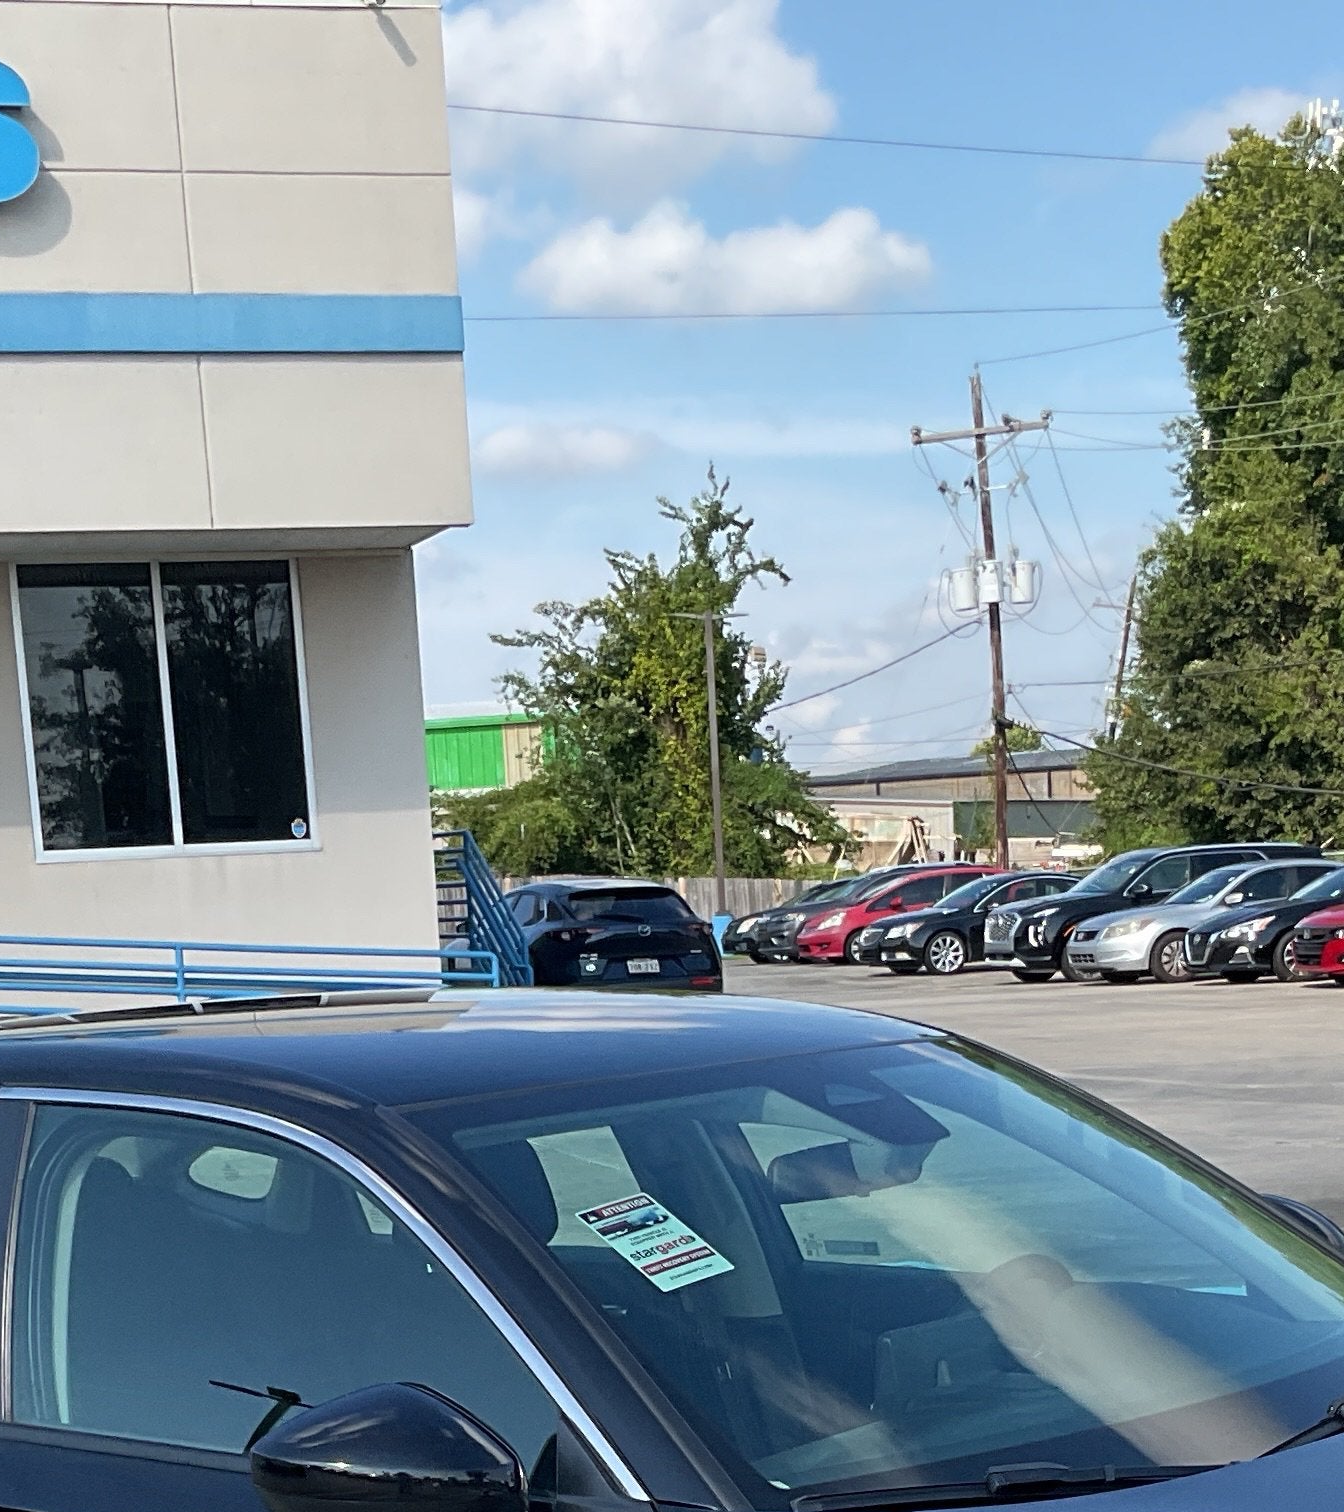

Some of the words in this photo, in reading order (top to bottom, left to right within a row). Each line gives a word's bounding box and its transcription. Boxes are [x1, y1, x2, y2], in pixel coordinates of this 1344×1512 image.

[601, 1196, 651, 1217] ATTENTION
[630, 1235, 690, 1261] stargard
[662, 1255, 690, 1268] RECOVERY
